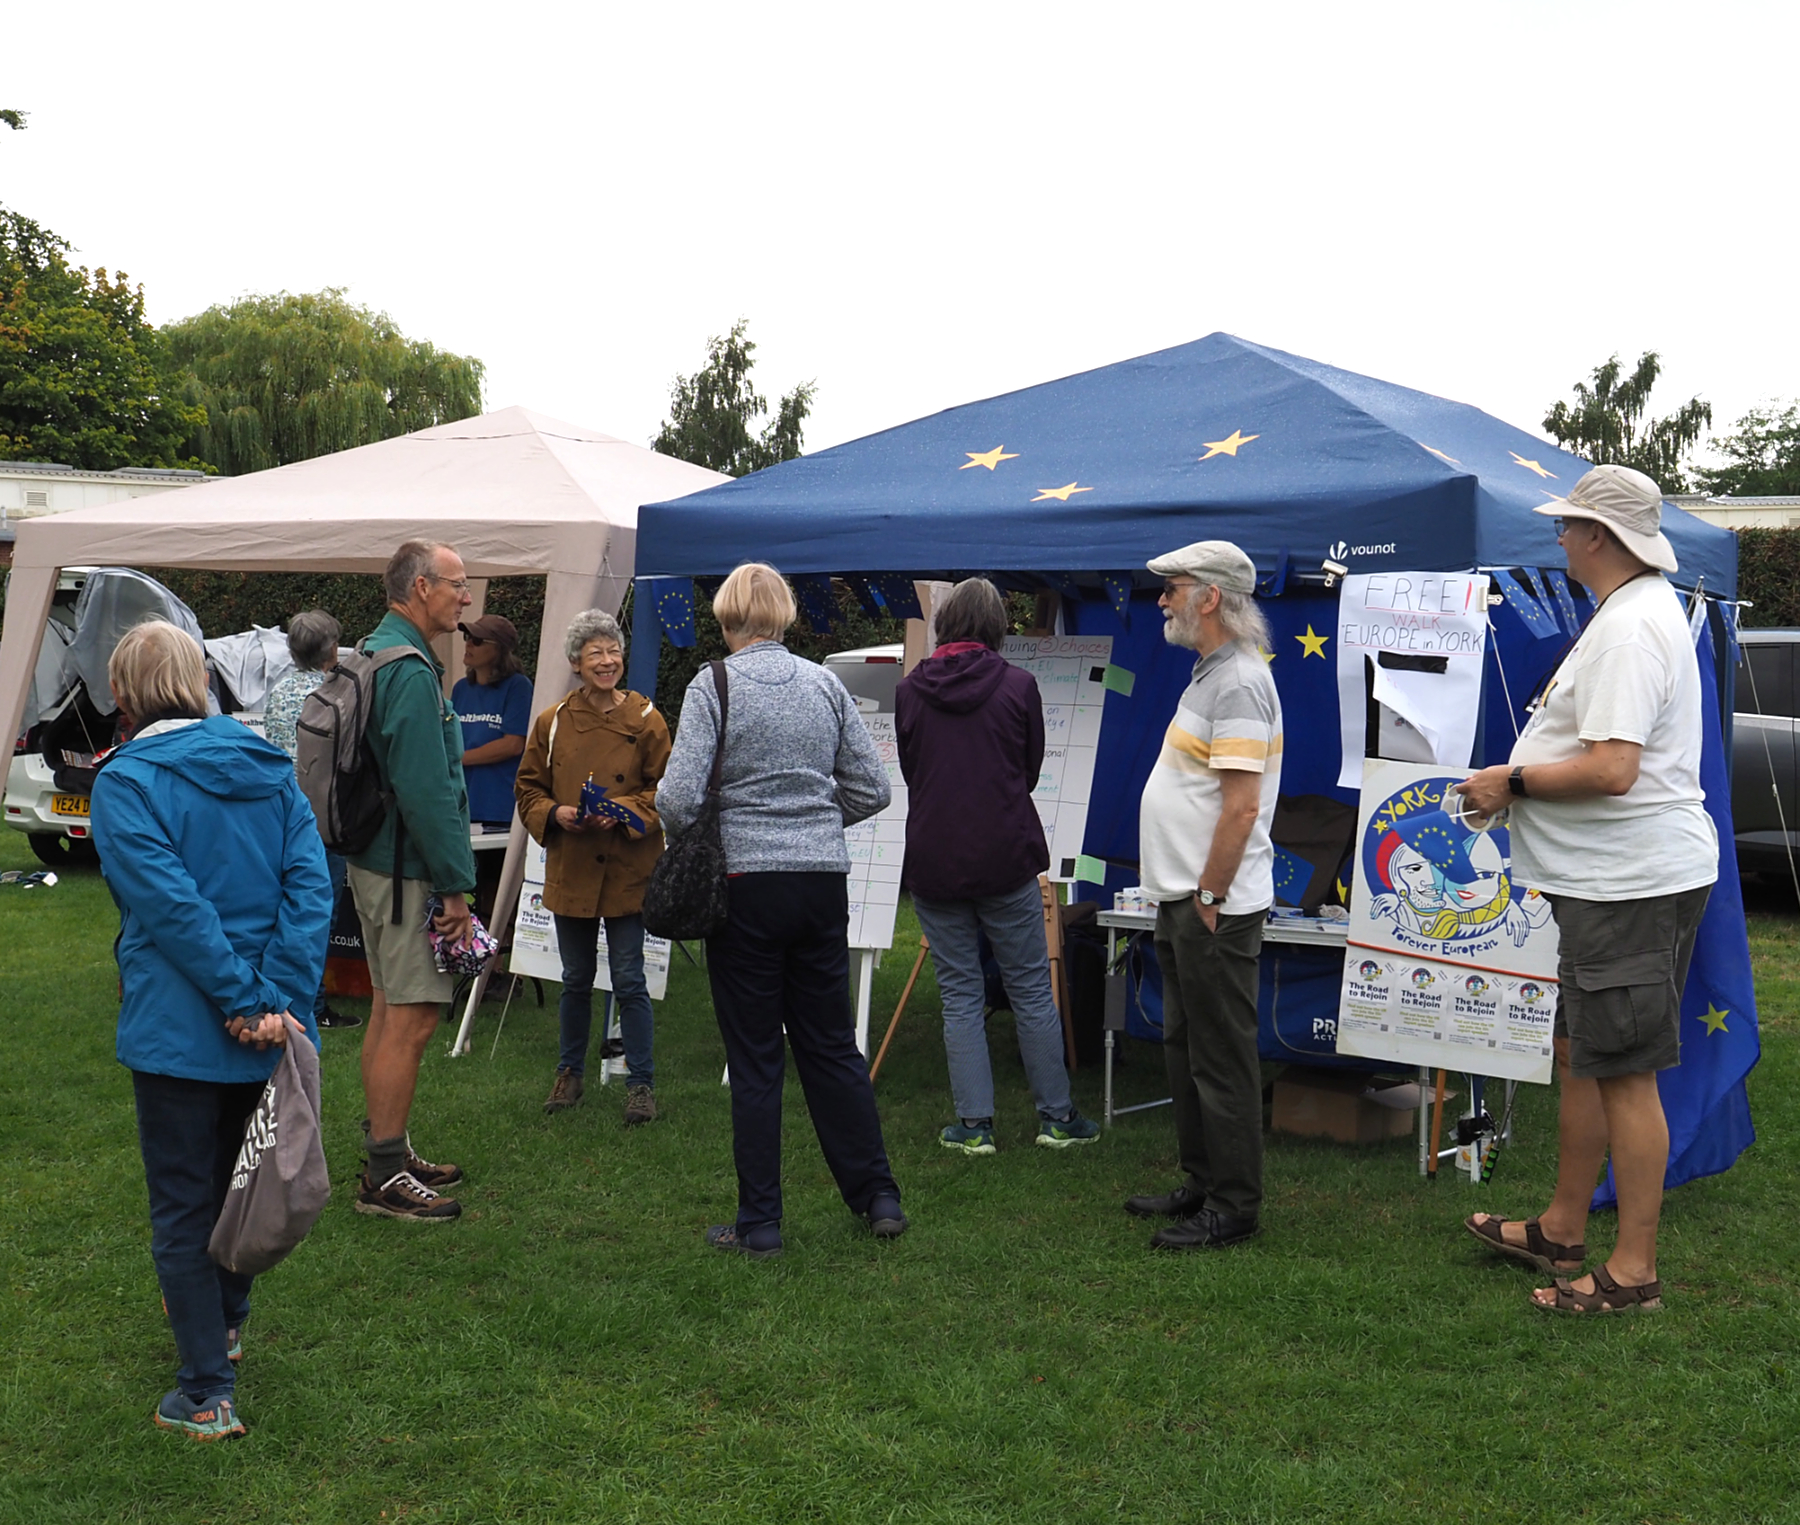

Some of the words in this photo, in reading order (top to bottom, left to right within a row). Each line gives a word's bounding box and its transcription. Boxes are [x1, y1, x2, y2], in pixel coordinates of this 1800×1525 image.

[1351, 542, 1396, 555] vounot
[1365, 576, 1473, 616] FREE!
[1392, 614, 1442, 630] WALK
[1060, 638, 1110, 655] choices
[1422, 639, 1434, 650] in
[1043, 673, 1079, 684] climate
[872, 718, 892, 731] the
[55, 796, 80, 812] YE24
[1380, 783, 1440, 823] YORK
[1392, 925, 1437, 952] Forever
[1442, 940, 1498, 957] European
[1349, 982, 1365, 990] The
[1367, 984, 1389, 993] Road
[1360, 990, 1388, 1001] Rejoin
[1401, 990, 1417, 998] The
[1420, 992, 1442, 1002] Road
[1412, 999, 1441, 1008] Rejoin
[1455, 997, 1471, 1005] The
[1473, 999, 1496, 1009] Road
[1467, 1006, 1495, 1016] Rejoin
[1509, 1004, 1525, 1013] The
[1528, 1007, 1551, 1016] Road
[1521, 1013, 1550, 1023] Rejoin
